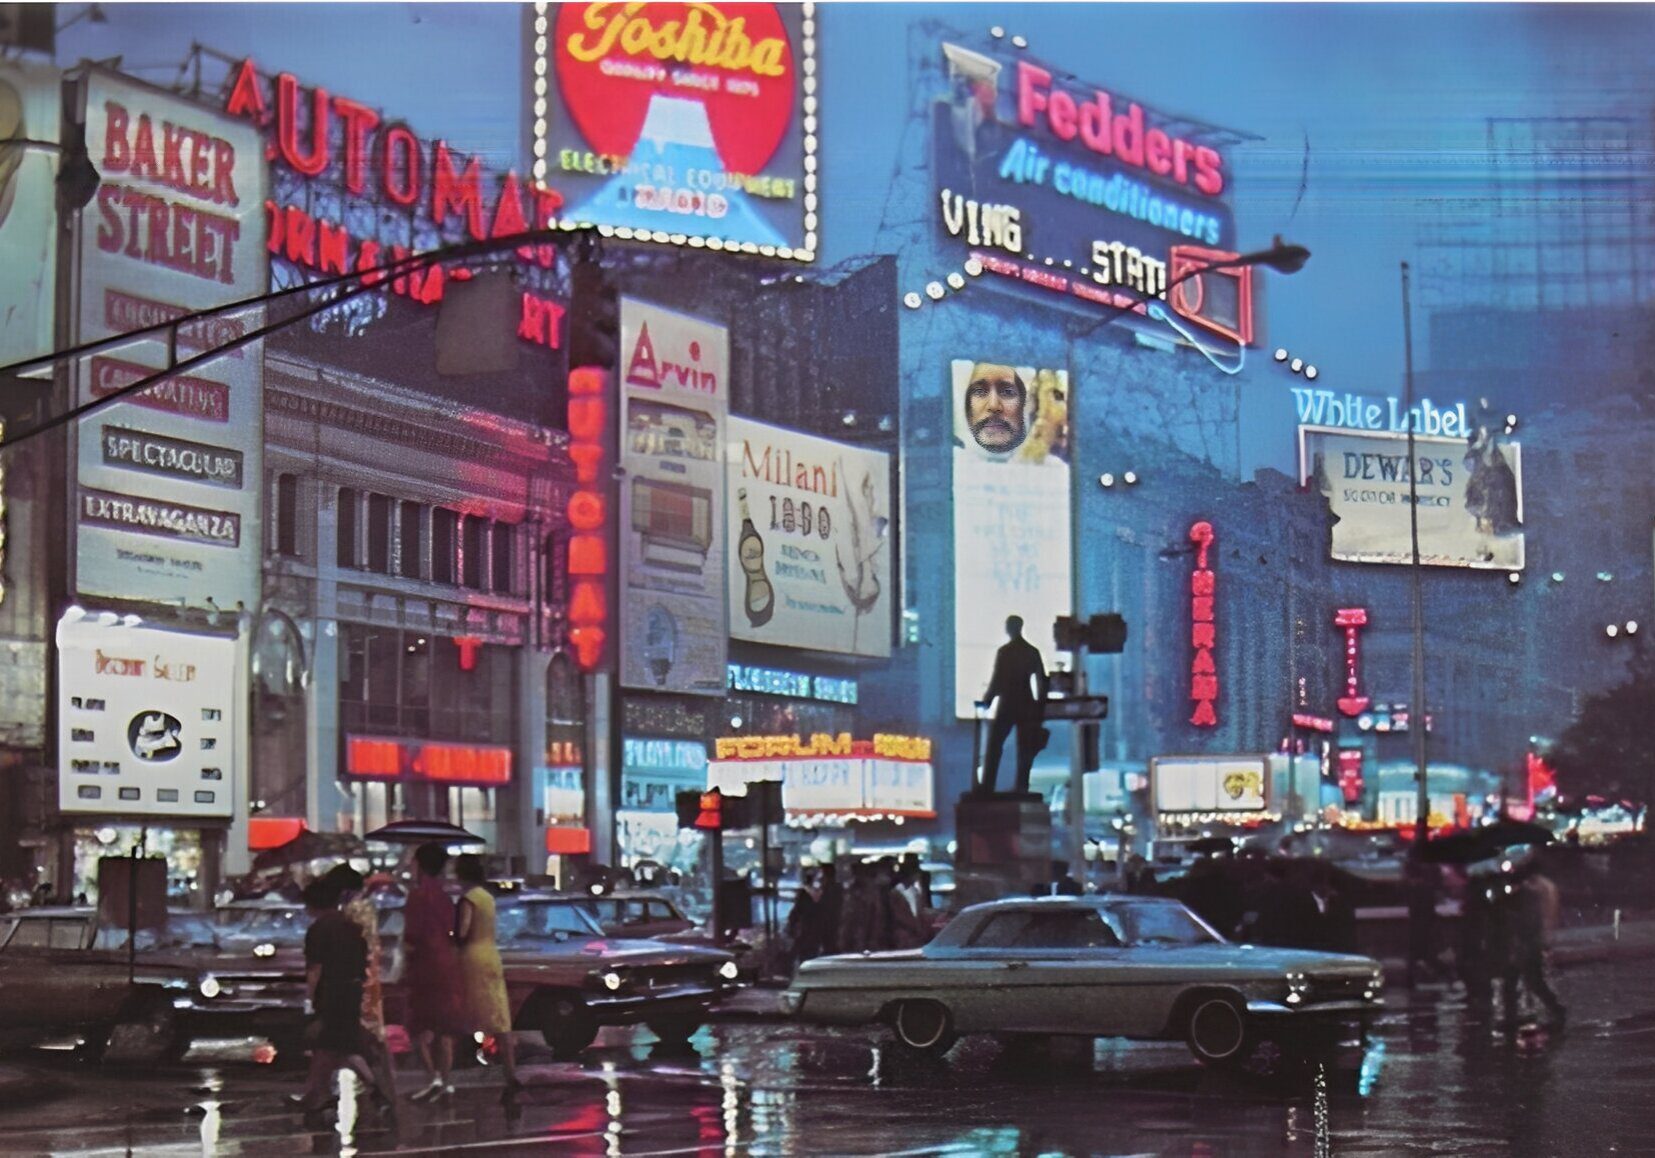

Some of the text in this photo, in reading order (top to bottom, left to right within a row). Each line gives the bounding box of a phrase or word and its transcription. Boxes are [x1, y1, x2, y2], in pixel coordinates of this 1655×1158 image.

[567, 2, 785, 76] Toshiba
[103, 100, 240, 208] BAKER
[226, 58, 564, 268] AUTOMAT
[1017, 61, 1223, 196] Fedders
[97, 184, 240, 285] STREET
[1000, 138, 1221, 245] Air conditioners
[626, 320, 717, 394] Arvin
[1387, 397, 1472, 438] Label
[743, 440, 838, 498] Milani
[715, 733, 852, 759] FORUM
